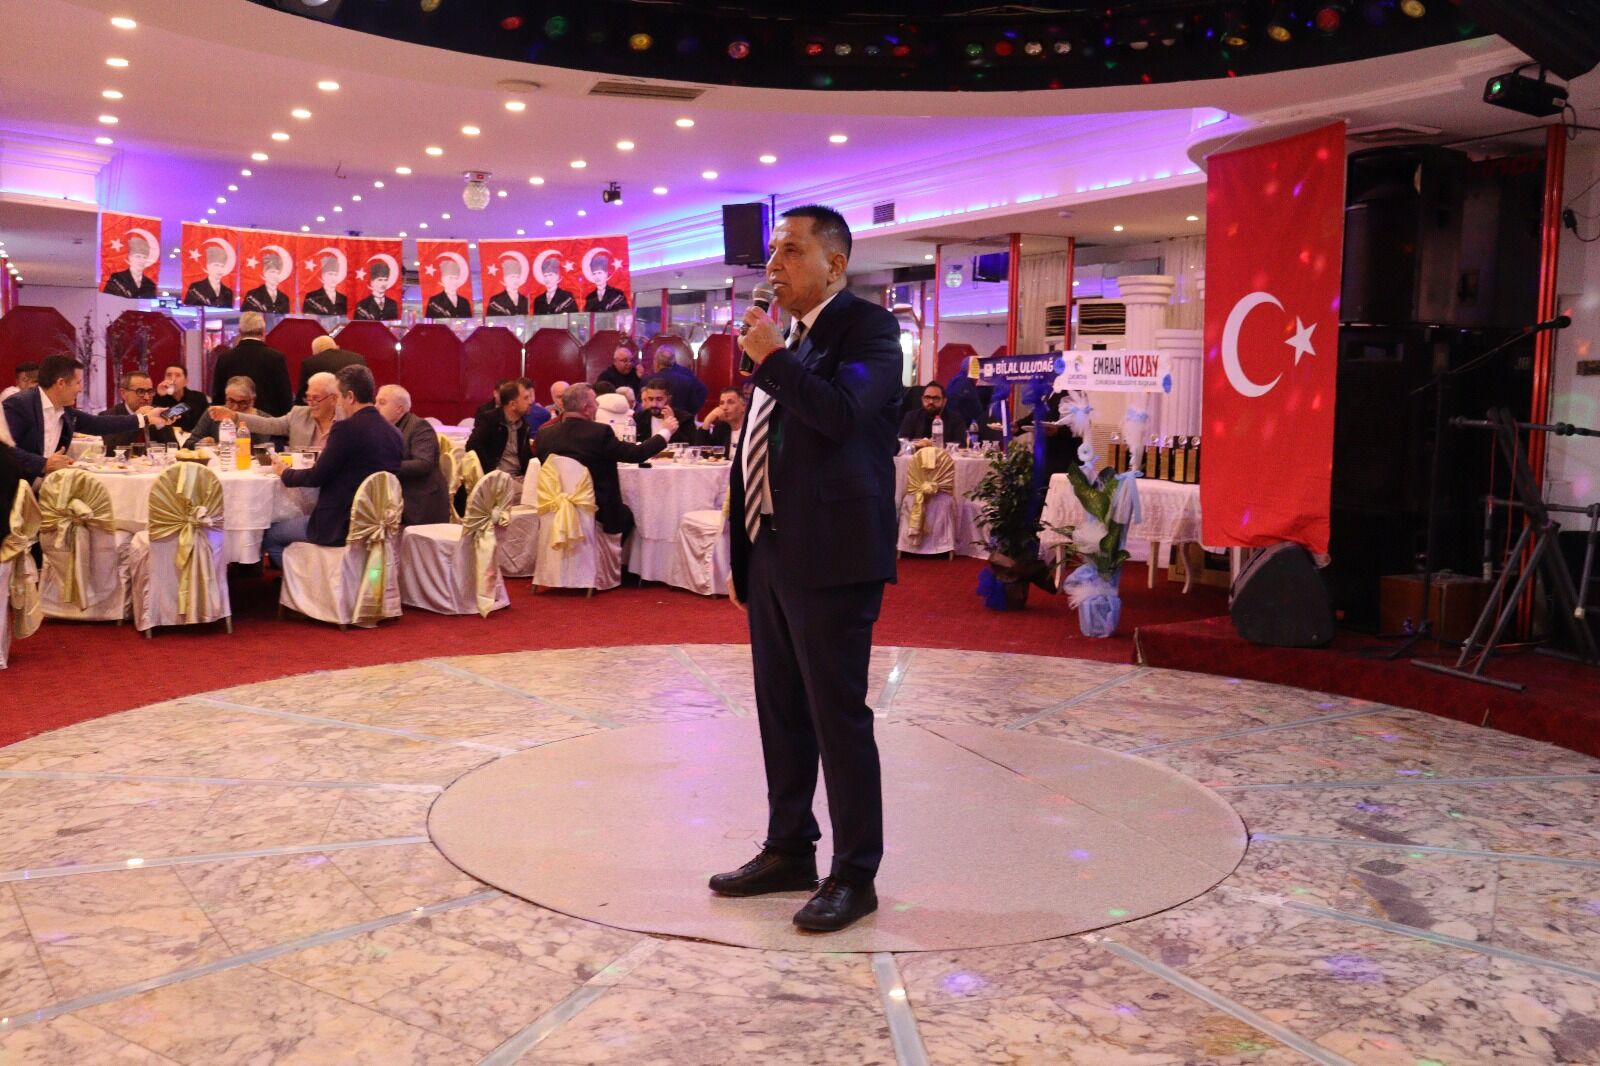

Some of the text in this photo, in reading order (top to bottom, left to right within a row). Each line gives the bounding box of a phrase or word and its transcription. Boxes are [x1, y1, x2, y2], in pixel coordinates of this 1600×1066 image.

[995, 357, 1054, 375] BİLAL ULUDAĞ
[1093, 355, 1159, 377] EMRAH KOZAY
